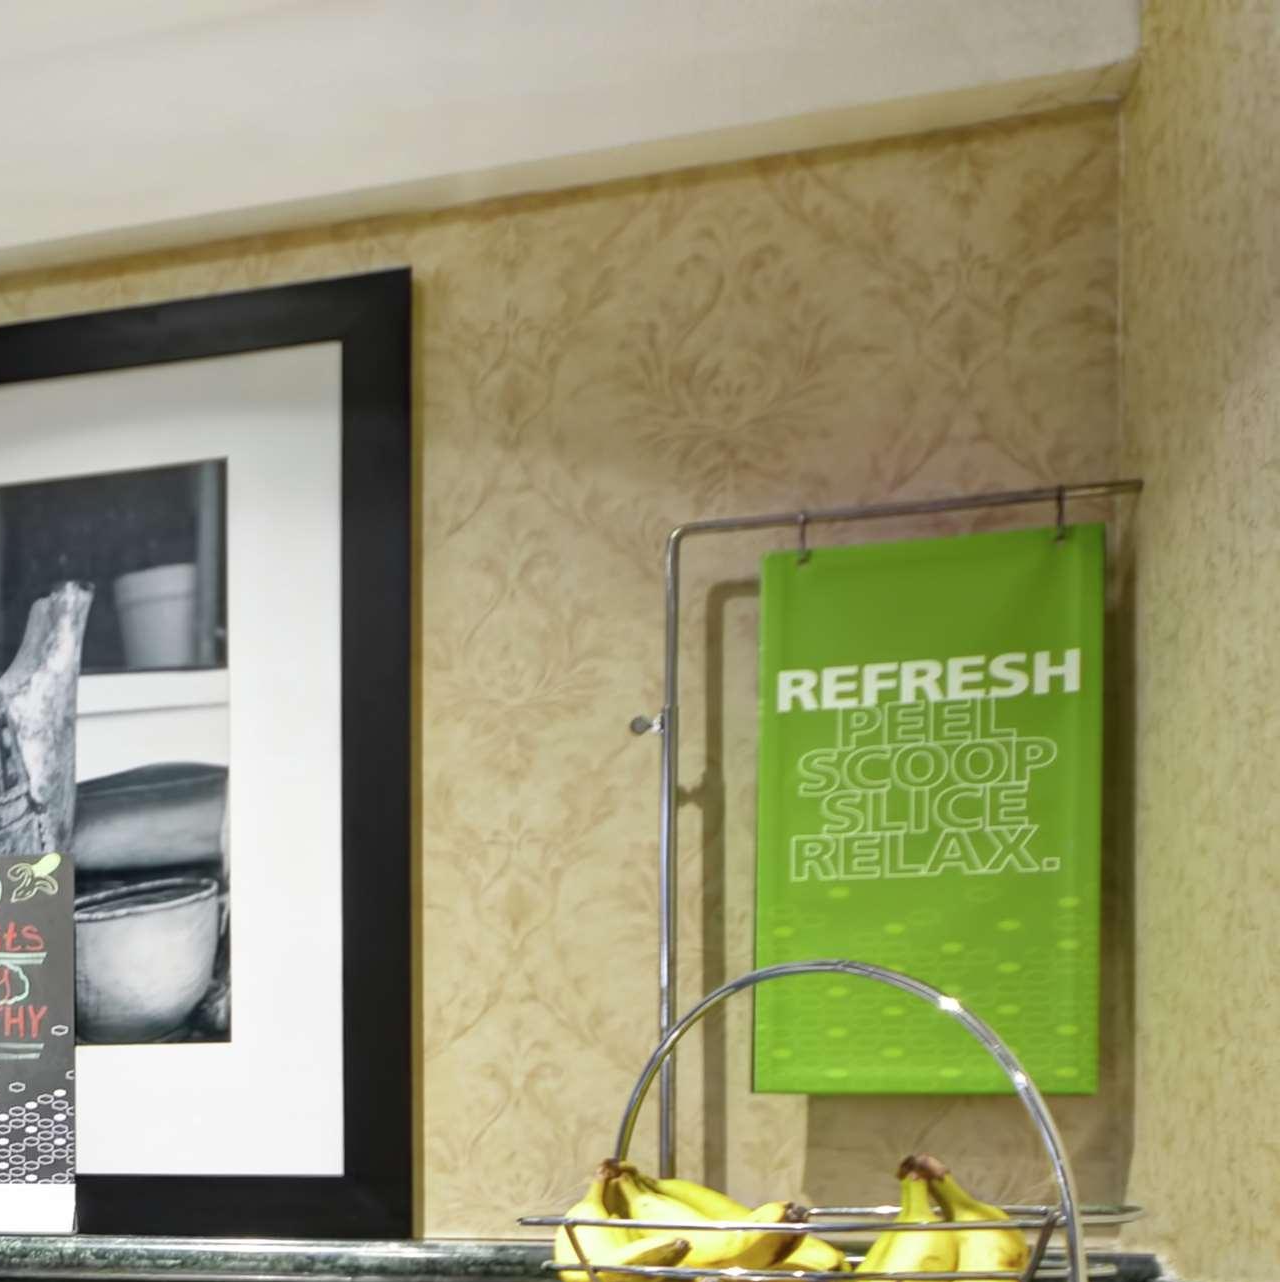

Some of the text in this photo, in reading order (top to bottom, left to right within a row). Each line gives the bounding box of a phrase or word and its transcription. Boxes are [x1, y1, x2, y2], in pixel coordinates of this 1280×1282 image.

[777, 648, 1081, 713] REFRESH
[838, 698, 1017, 750] PEEL
[797, 736, 1058, 798] SCOOP
[822, 782, 1029, 836] SLICE
[790, 825, 1061, 882] RELAX.
